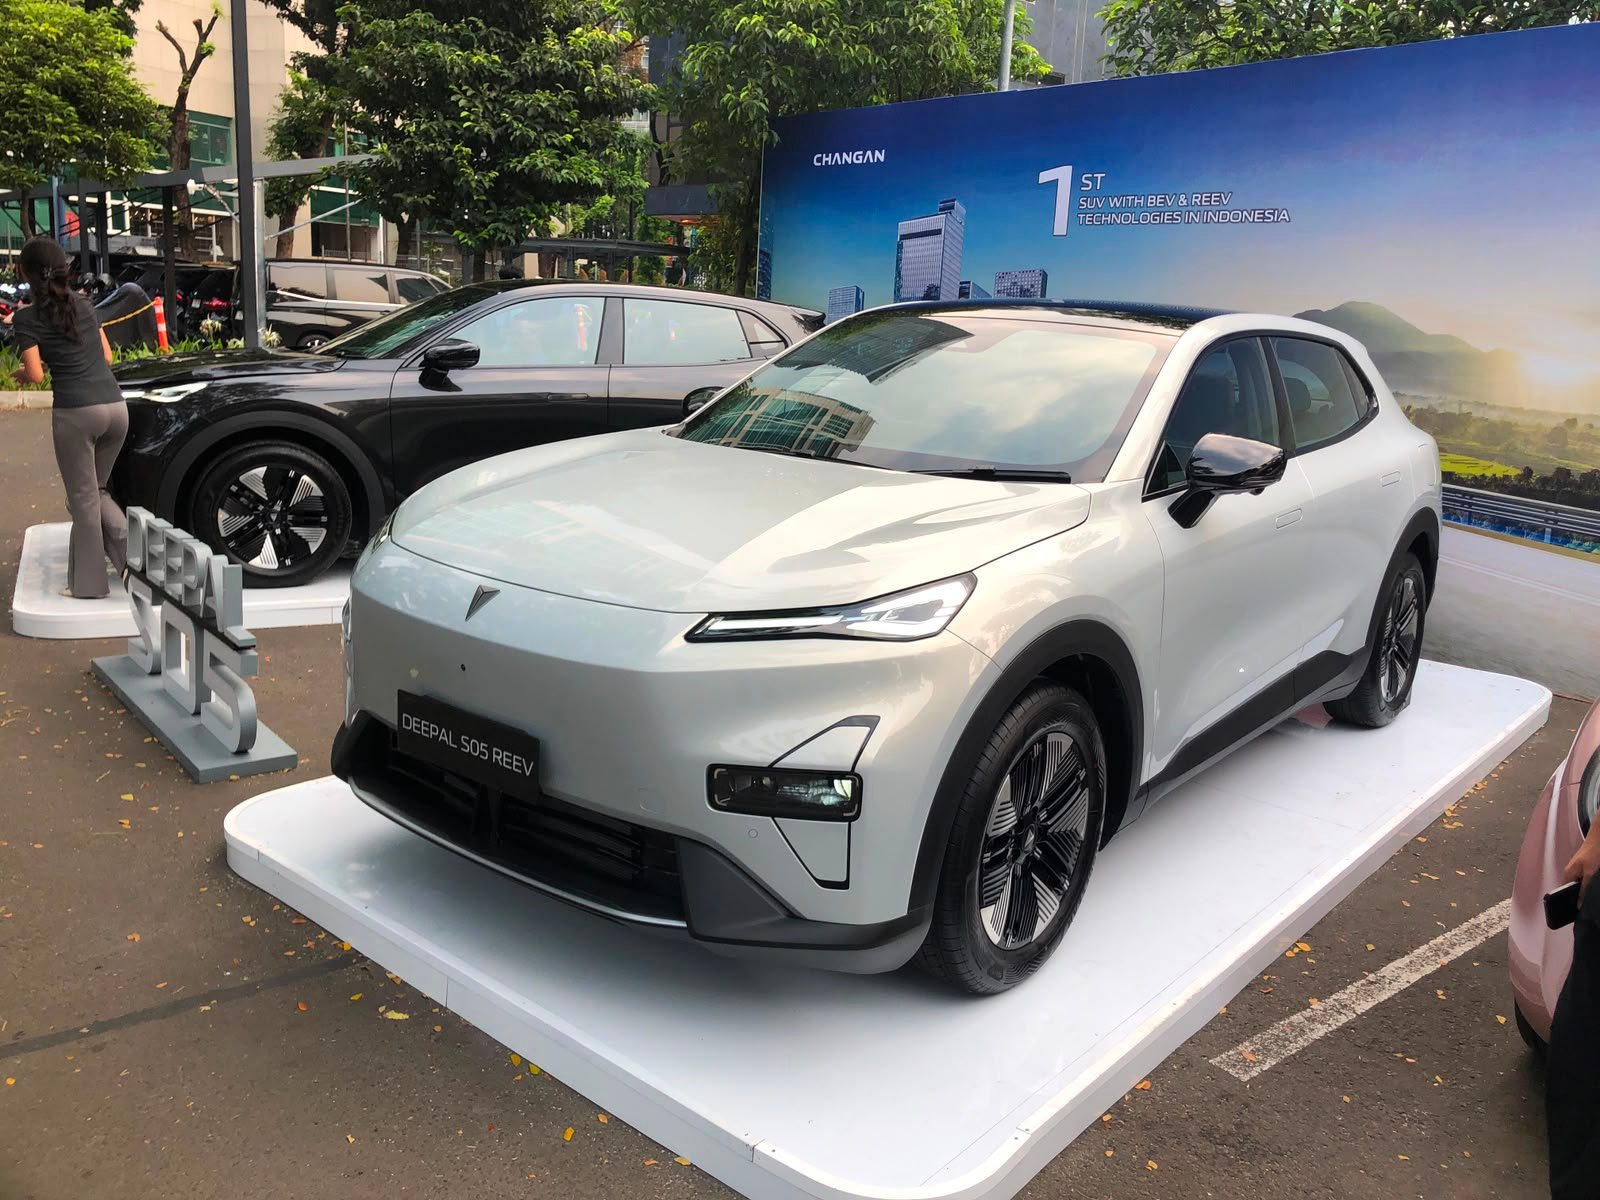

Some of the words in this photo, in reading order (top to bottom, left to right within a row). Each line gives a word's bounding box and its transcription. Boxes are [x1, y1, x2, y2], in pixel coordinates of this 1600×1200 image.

[812, 149, 886, 167] CHANGAN
[1037, 164, 1074, 237] 1
[1079, 172, 1107, 191] ST
[1078, 196, 1106, 209] SUV
[1107, 194, 1145, 209] WITH
[1146, 194, 1176, 208] BEV
[1177, 193, 1188, 207] &
[1191, 192, 1233, 206] REEV
[1077, 211, 1182, 226] TECHNOLOGIES
[1184, 211, 1201, 224] IN
[1202, 208, 1291, 224] INDONESIA
[401, 713, 458, 749] DEEPAL
[460, 735, 489, 761] S05
[492, 747, 535, 777] REEV
